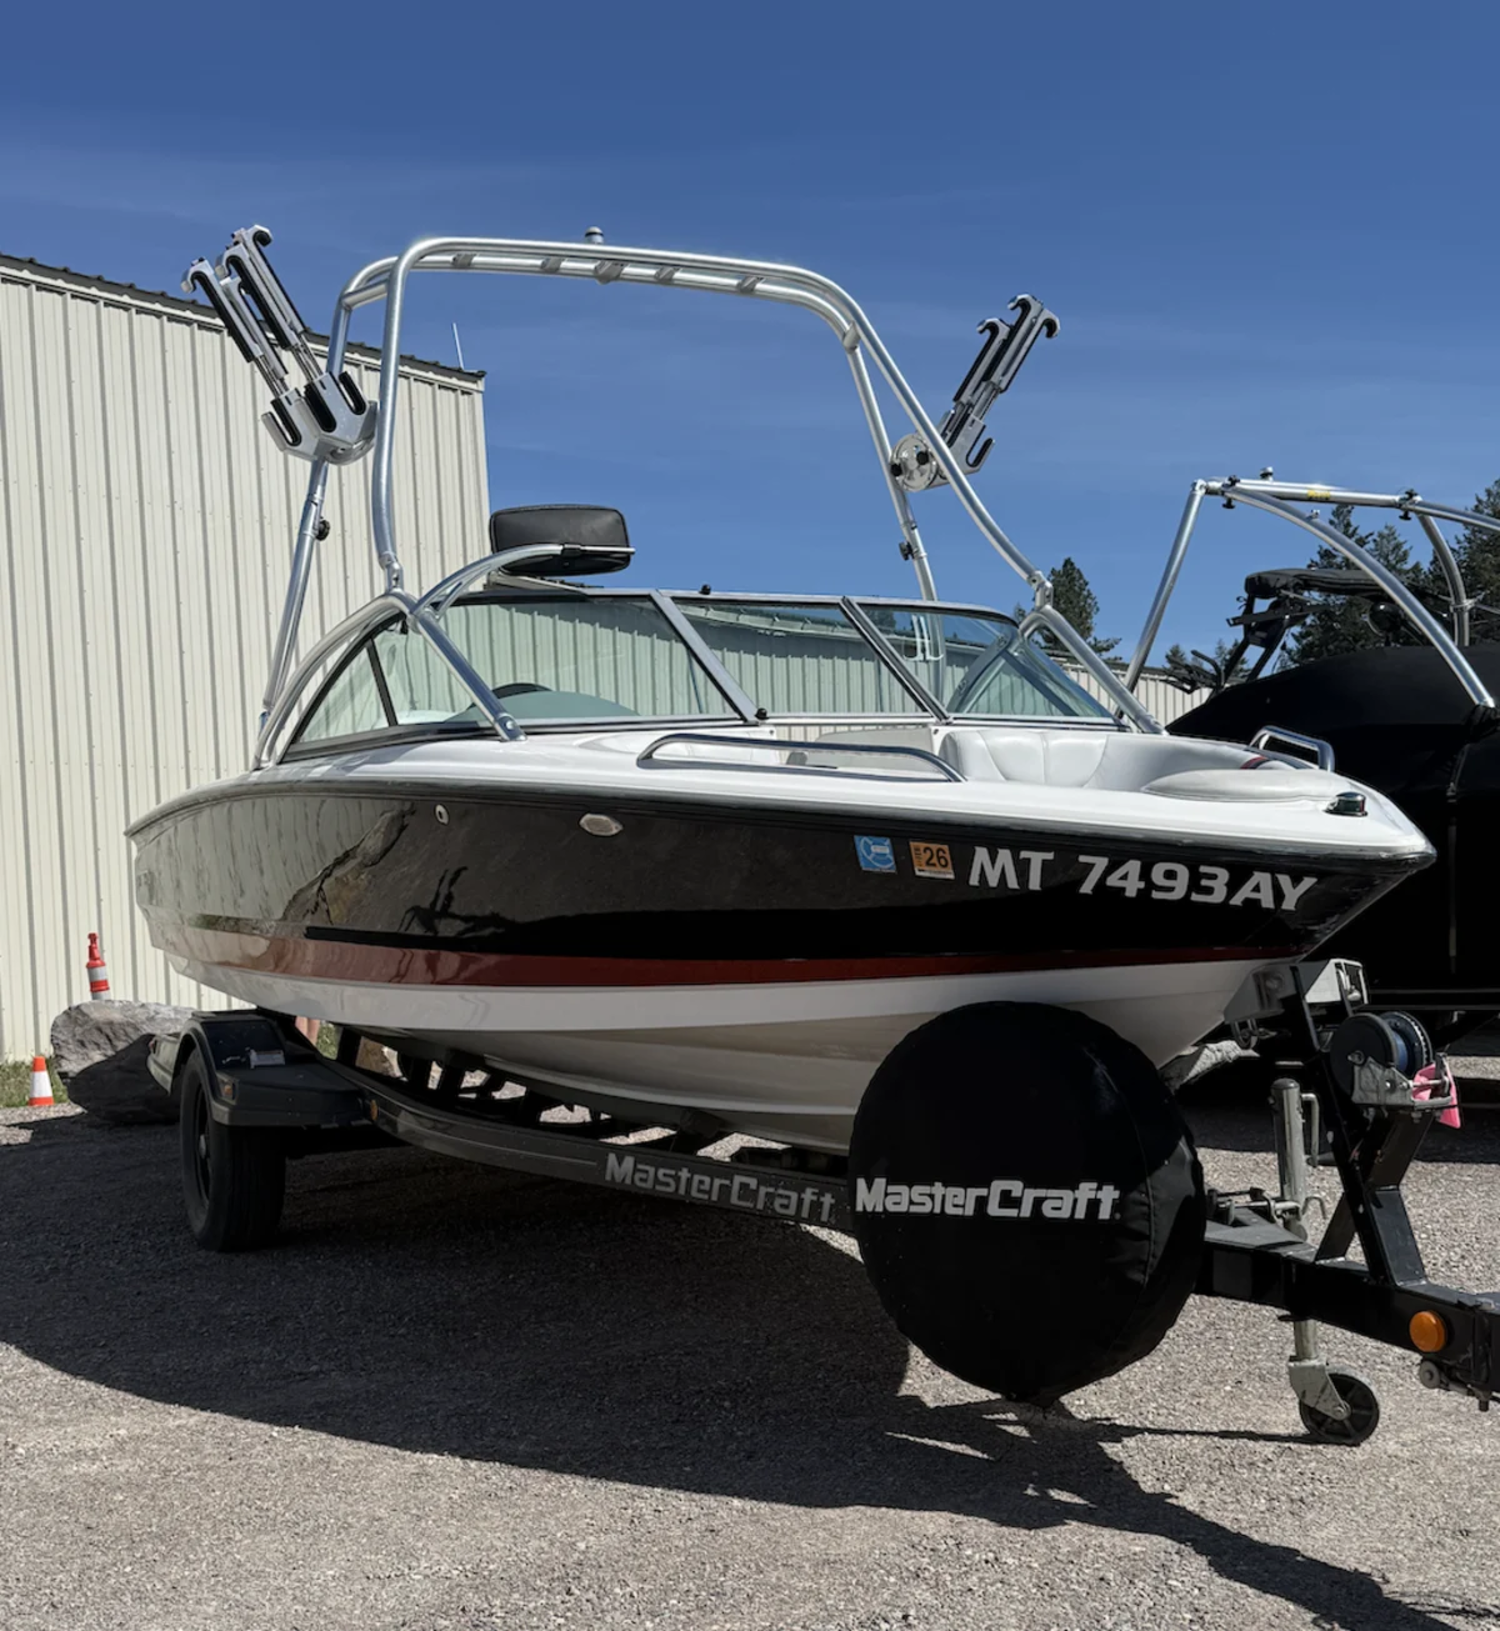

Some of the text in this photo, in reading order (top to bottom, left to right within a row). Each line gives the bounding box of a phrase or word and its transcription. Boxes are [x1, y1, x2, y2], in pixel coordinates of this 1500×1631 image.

[924, 847, 949, 868] 26
[968, 846, 1054, 891] MT
[1077, 855, 1318, 911] 7493AY
[604, 1152, 836, 1222] MasterCraft
[855, 1178, 1120, 1220] MasterCraft
